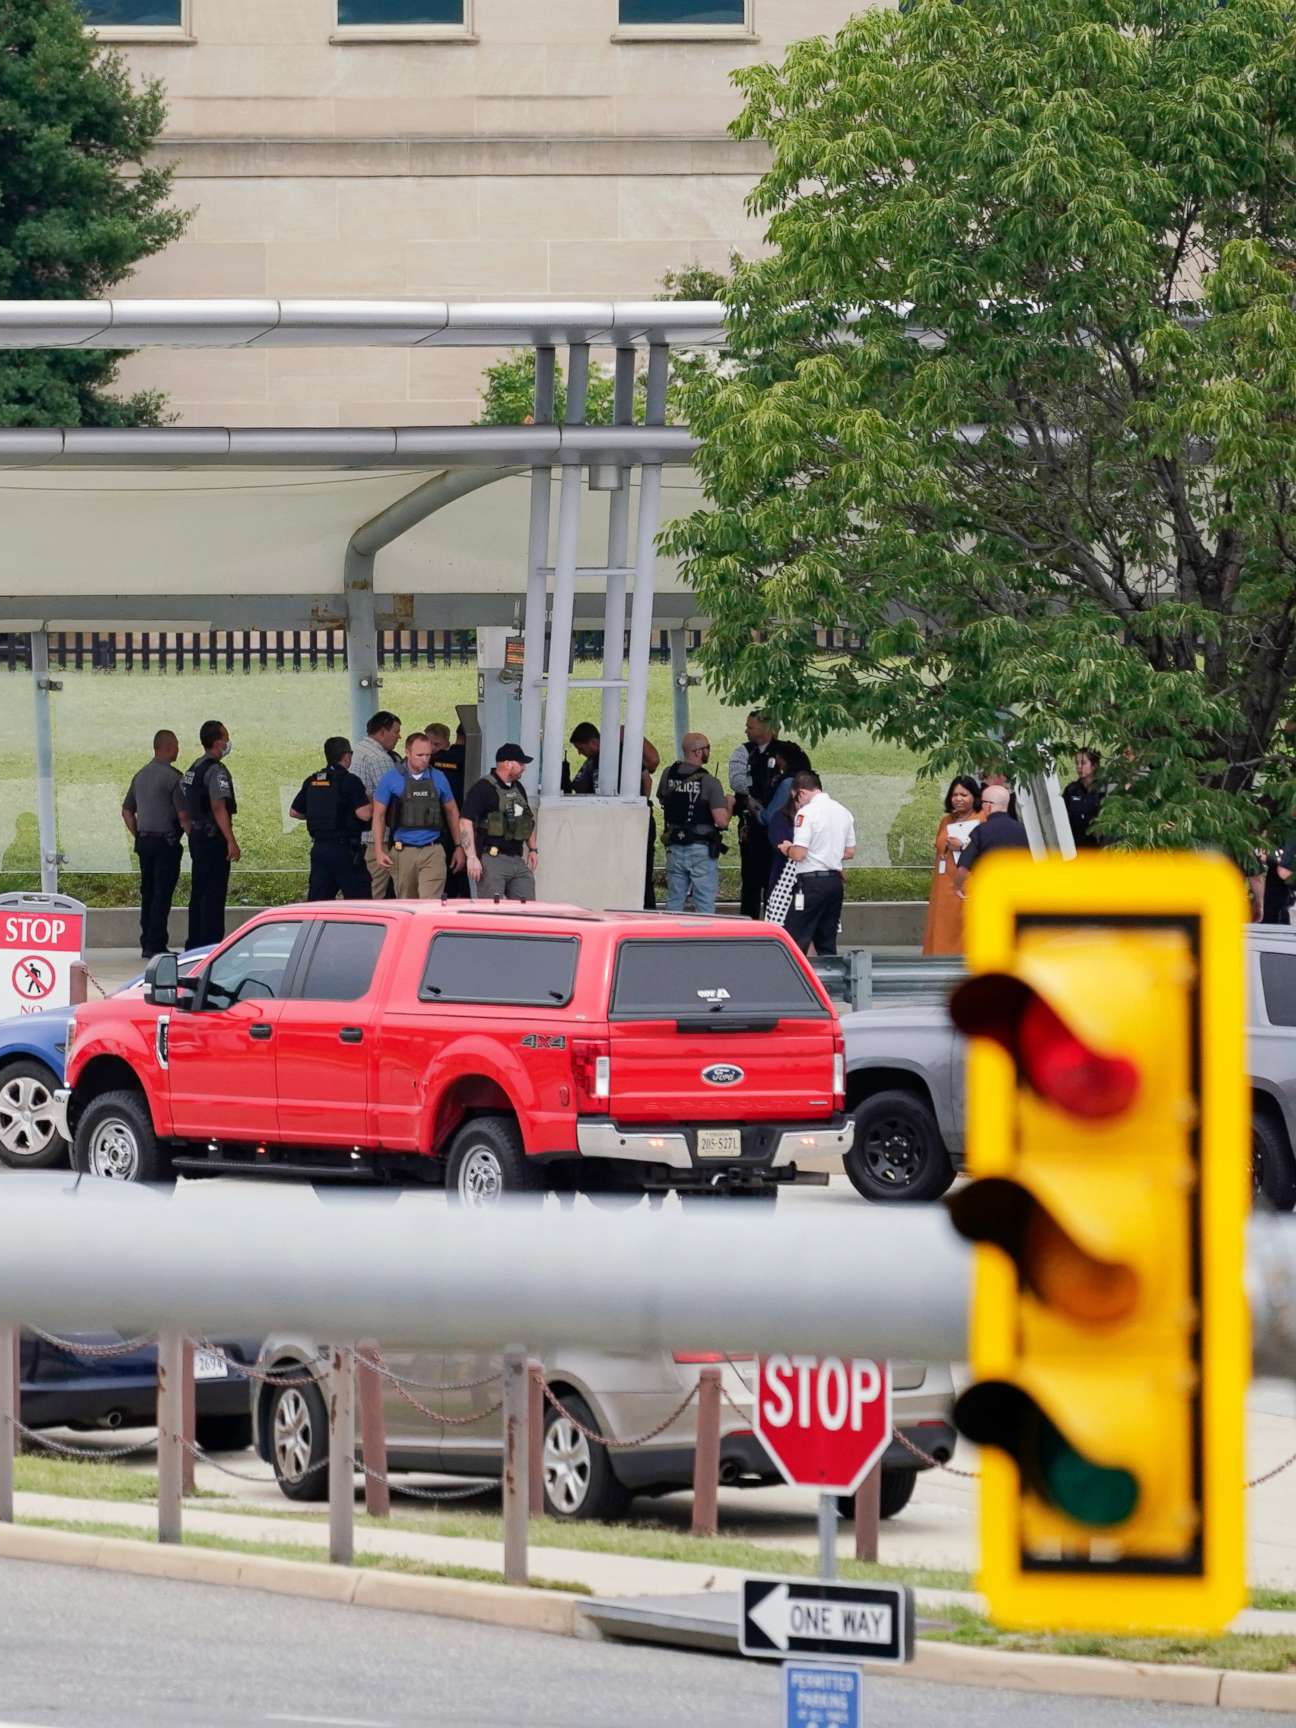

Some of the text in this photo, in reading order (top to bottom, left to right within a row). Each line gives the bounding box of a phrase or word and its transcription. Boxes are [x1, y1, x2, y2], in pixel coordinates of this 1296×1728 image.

[667, 778, 701, 793] POLICE
[5, 917, 66, 944] STOP
[711, 1067, 736, 1081] Ford
[762, 1352, 882, 1432] STOP
[791, 1605, 885, 1638] ONE WAY
